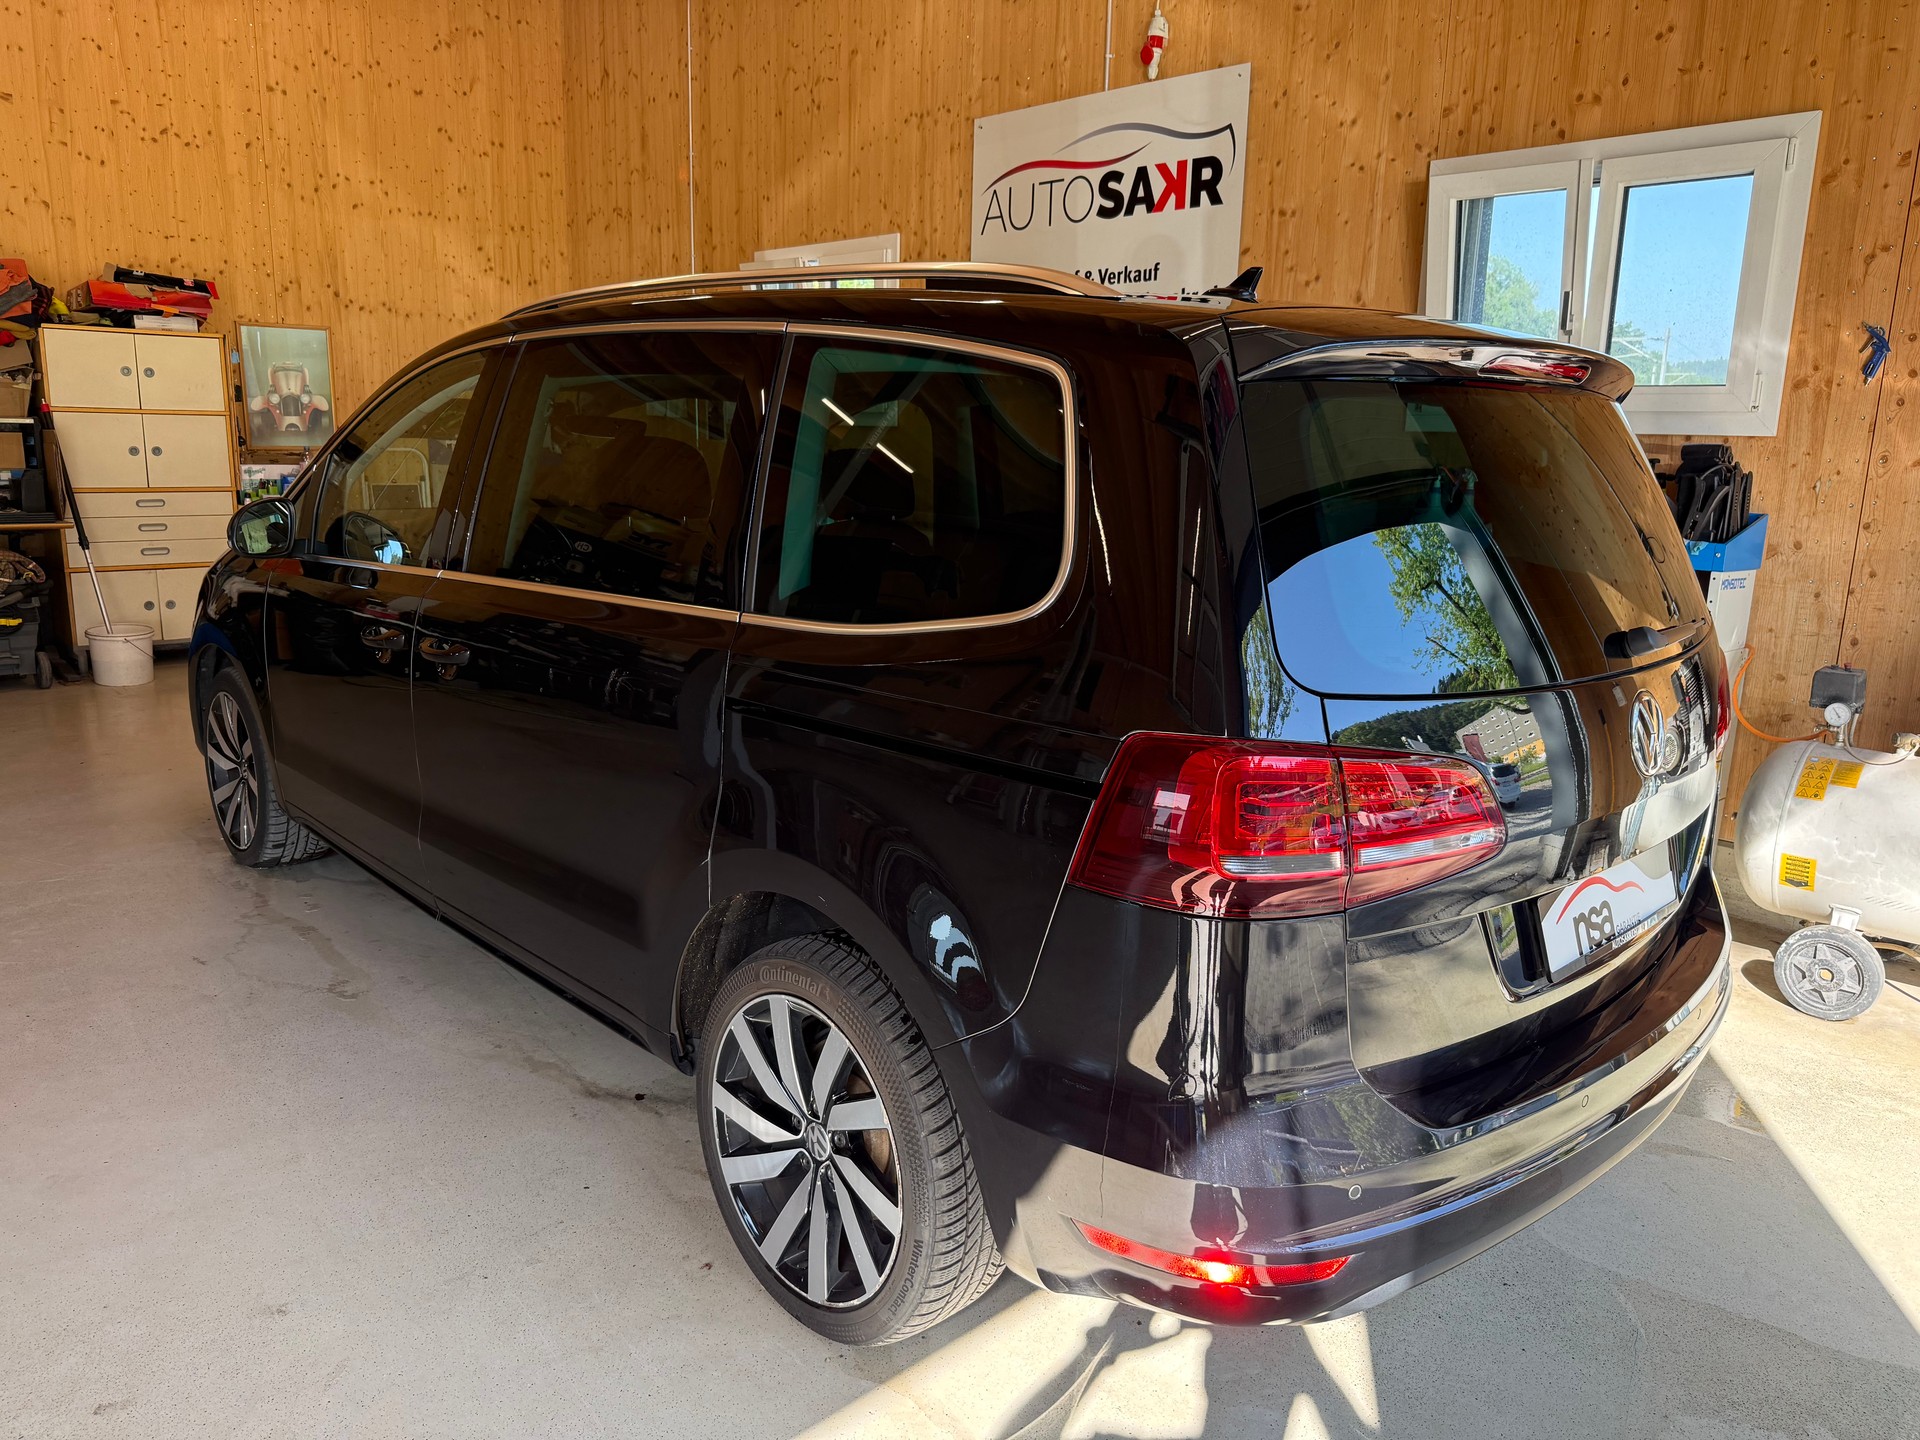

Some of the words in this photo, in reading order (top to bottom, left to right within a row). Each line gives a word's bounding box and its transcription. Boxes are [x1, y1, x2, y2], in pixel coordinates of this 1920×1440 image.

[1098, 262, 1161, 285] Verkauf
[1572, 900, 1615, 956] nsa
[760, 965, 821, 997] Continental
[888, 1239, 923, 1316] WinterContact
